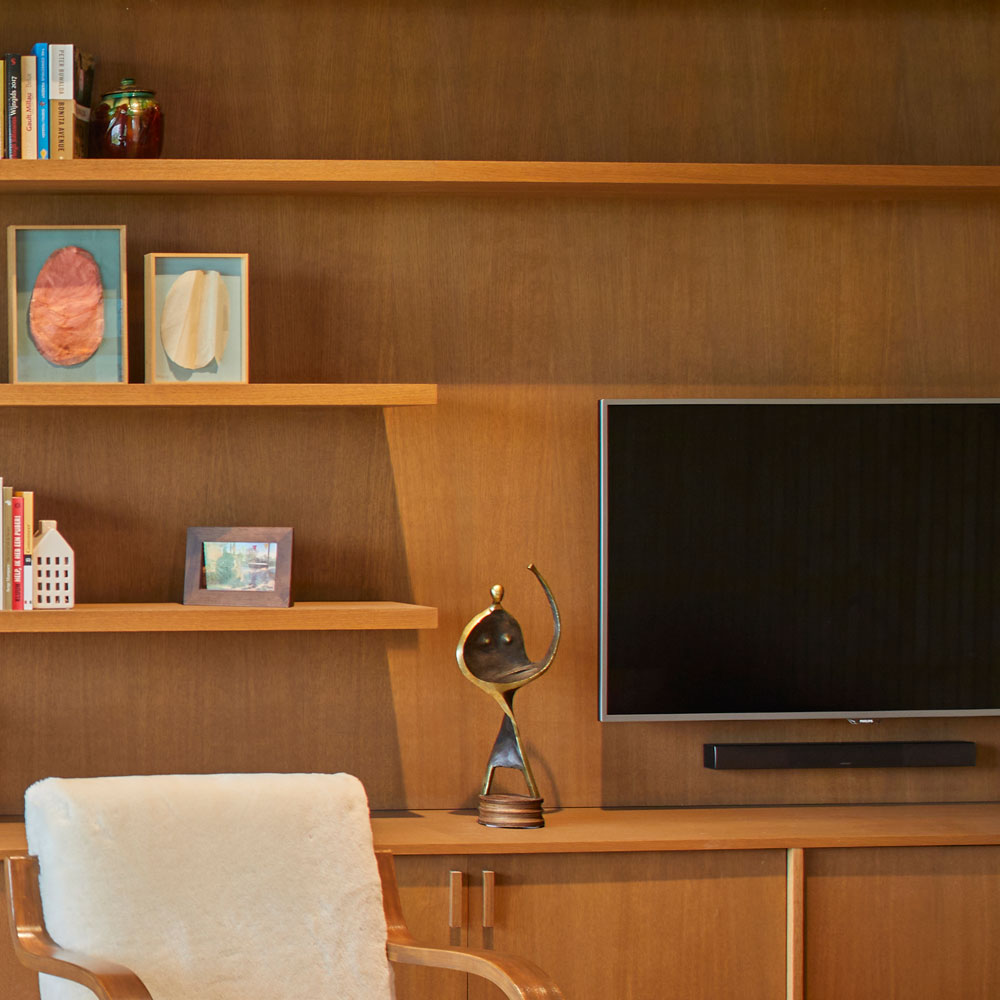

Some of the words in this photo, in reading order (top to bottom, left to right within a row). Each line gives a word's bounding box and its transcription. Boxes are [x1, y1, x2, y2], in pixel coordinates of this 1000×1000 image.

[9, 89, 19, 116] Wijngids
[13, 515, 21, 536] PUBER!
[14, 567, 22, 583] HELP,
